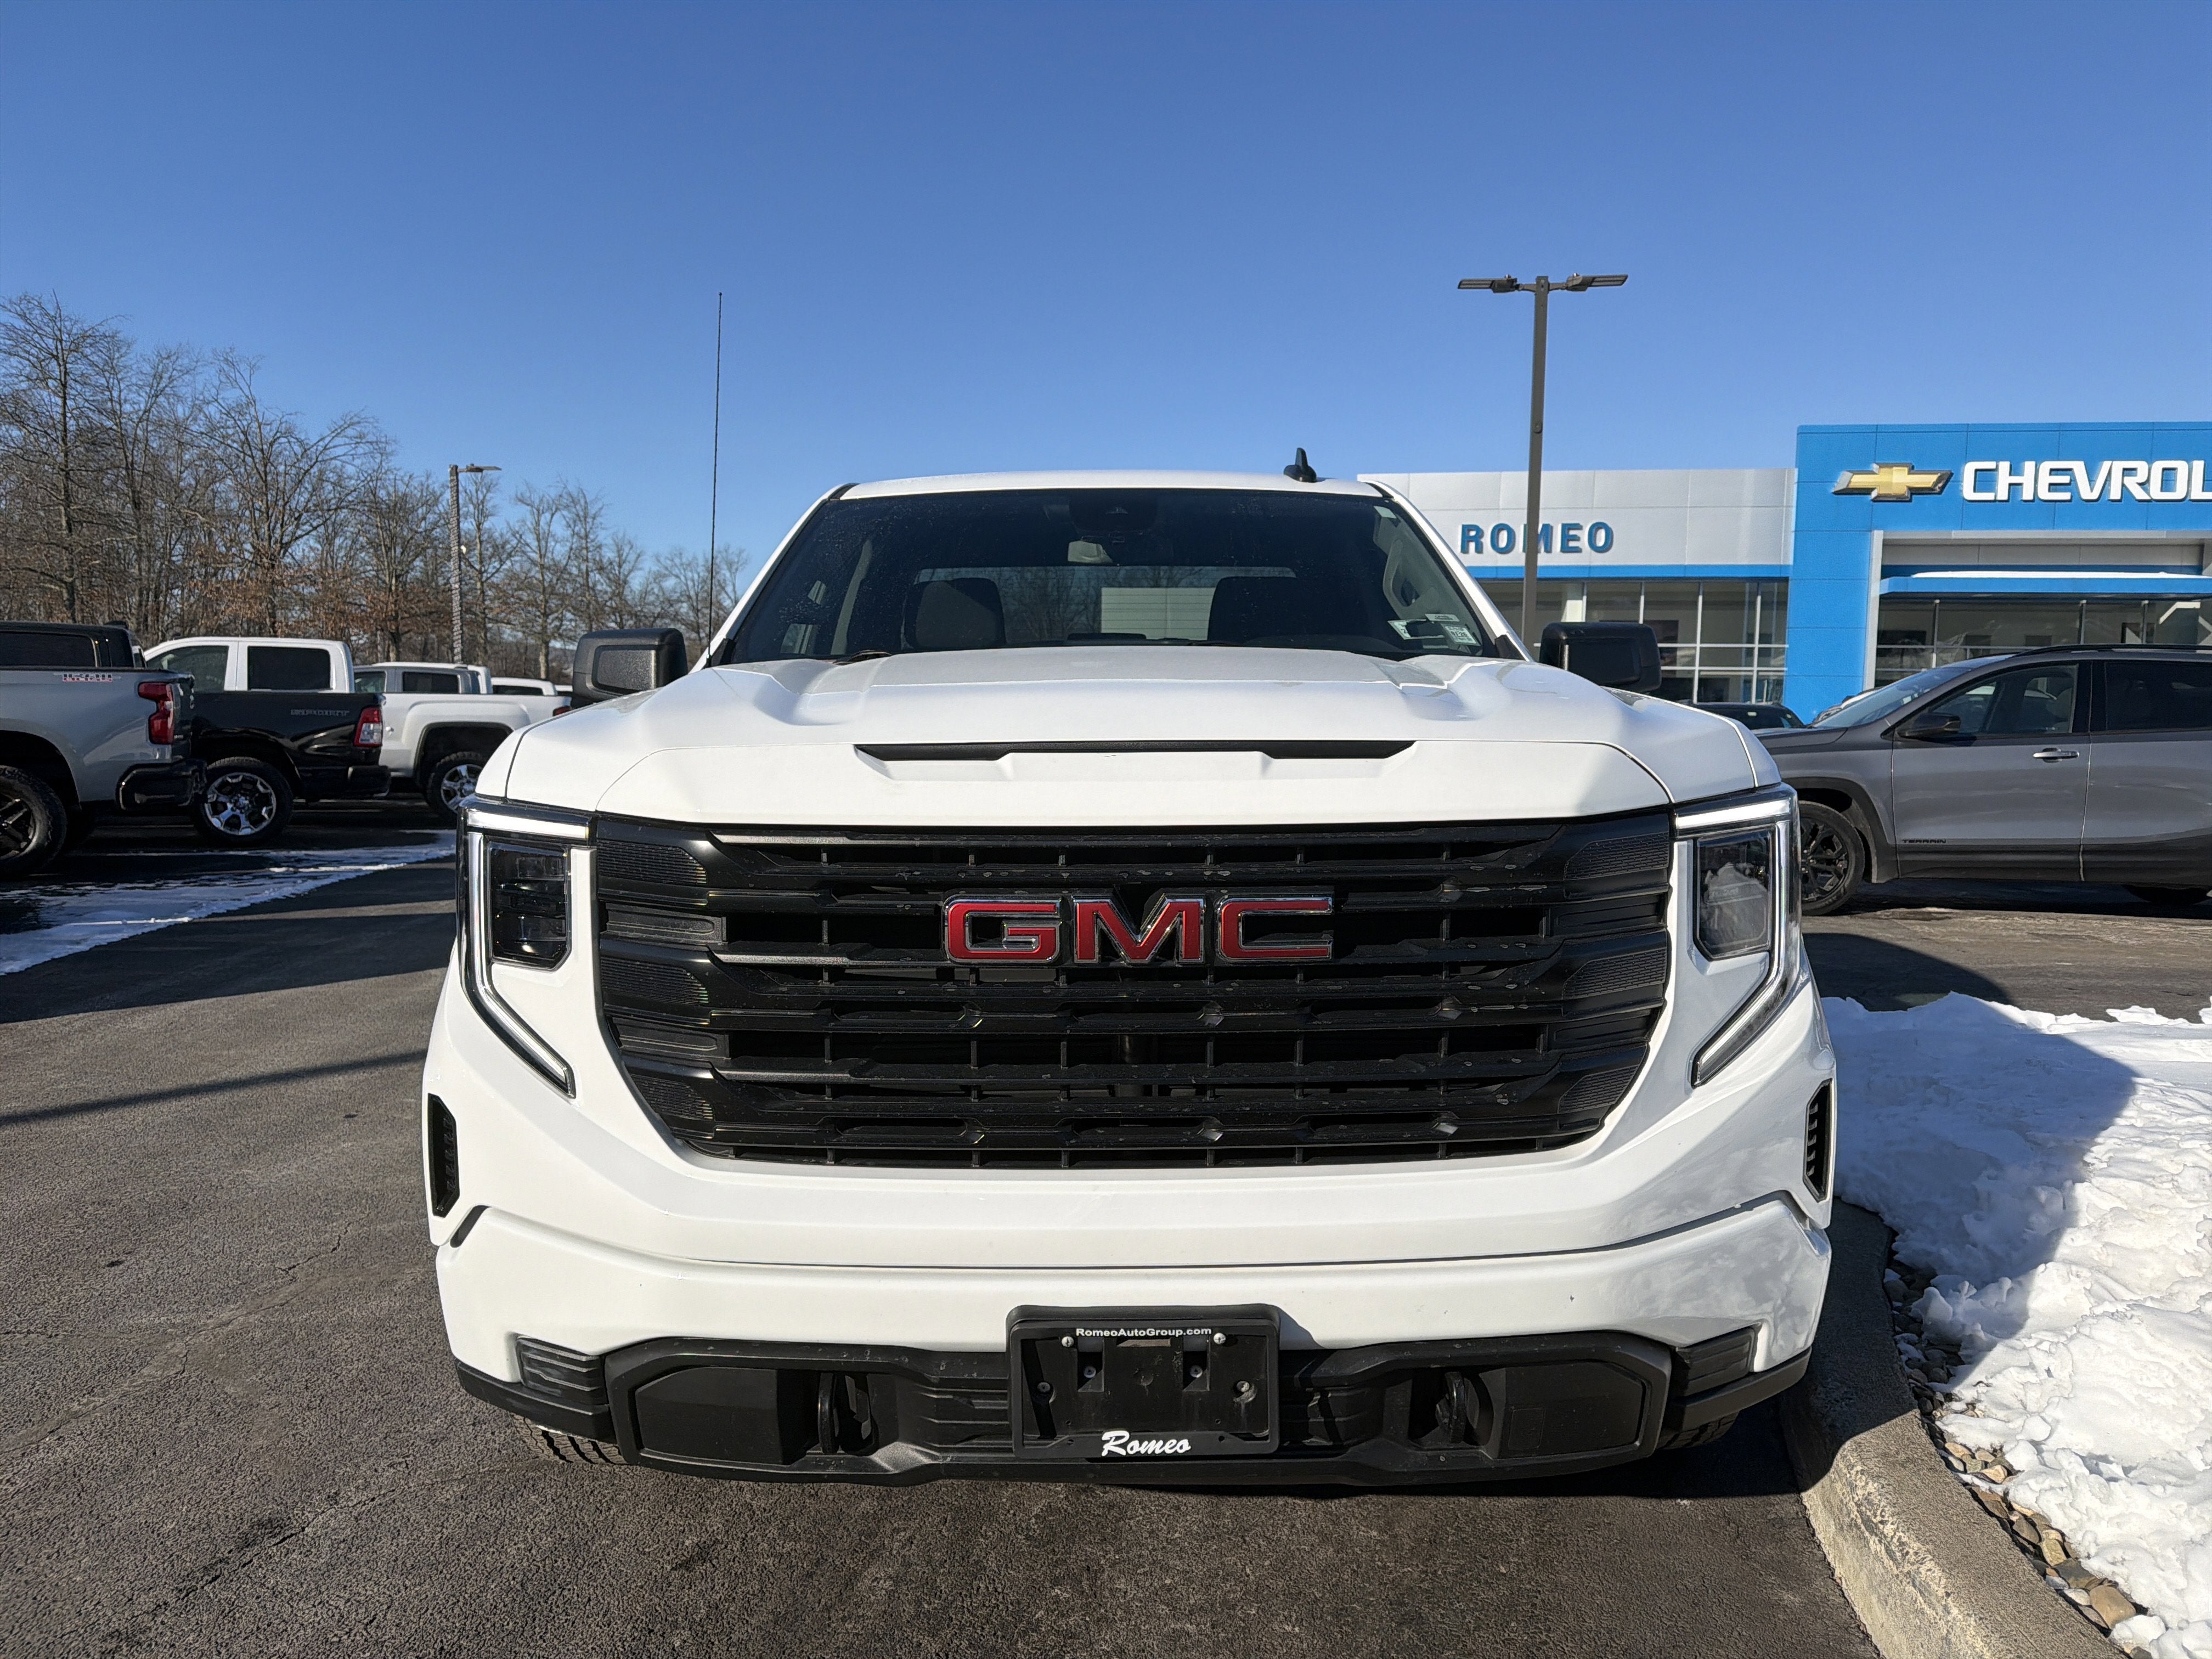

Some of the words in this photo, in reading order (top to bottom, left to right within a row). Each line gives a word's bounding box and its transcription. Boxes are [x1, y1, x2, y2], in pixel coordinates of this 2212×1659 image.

[1460, 522, 1613, 554] ROMEO
[943, 894, 1333, 964] GMC
[1076, 1328, 1212, 1337] RomeoAutoGroup.com
[1101, 1430, 1192, 1457] Romeo
